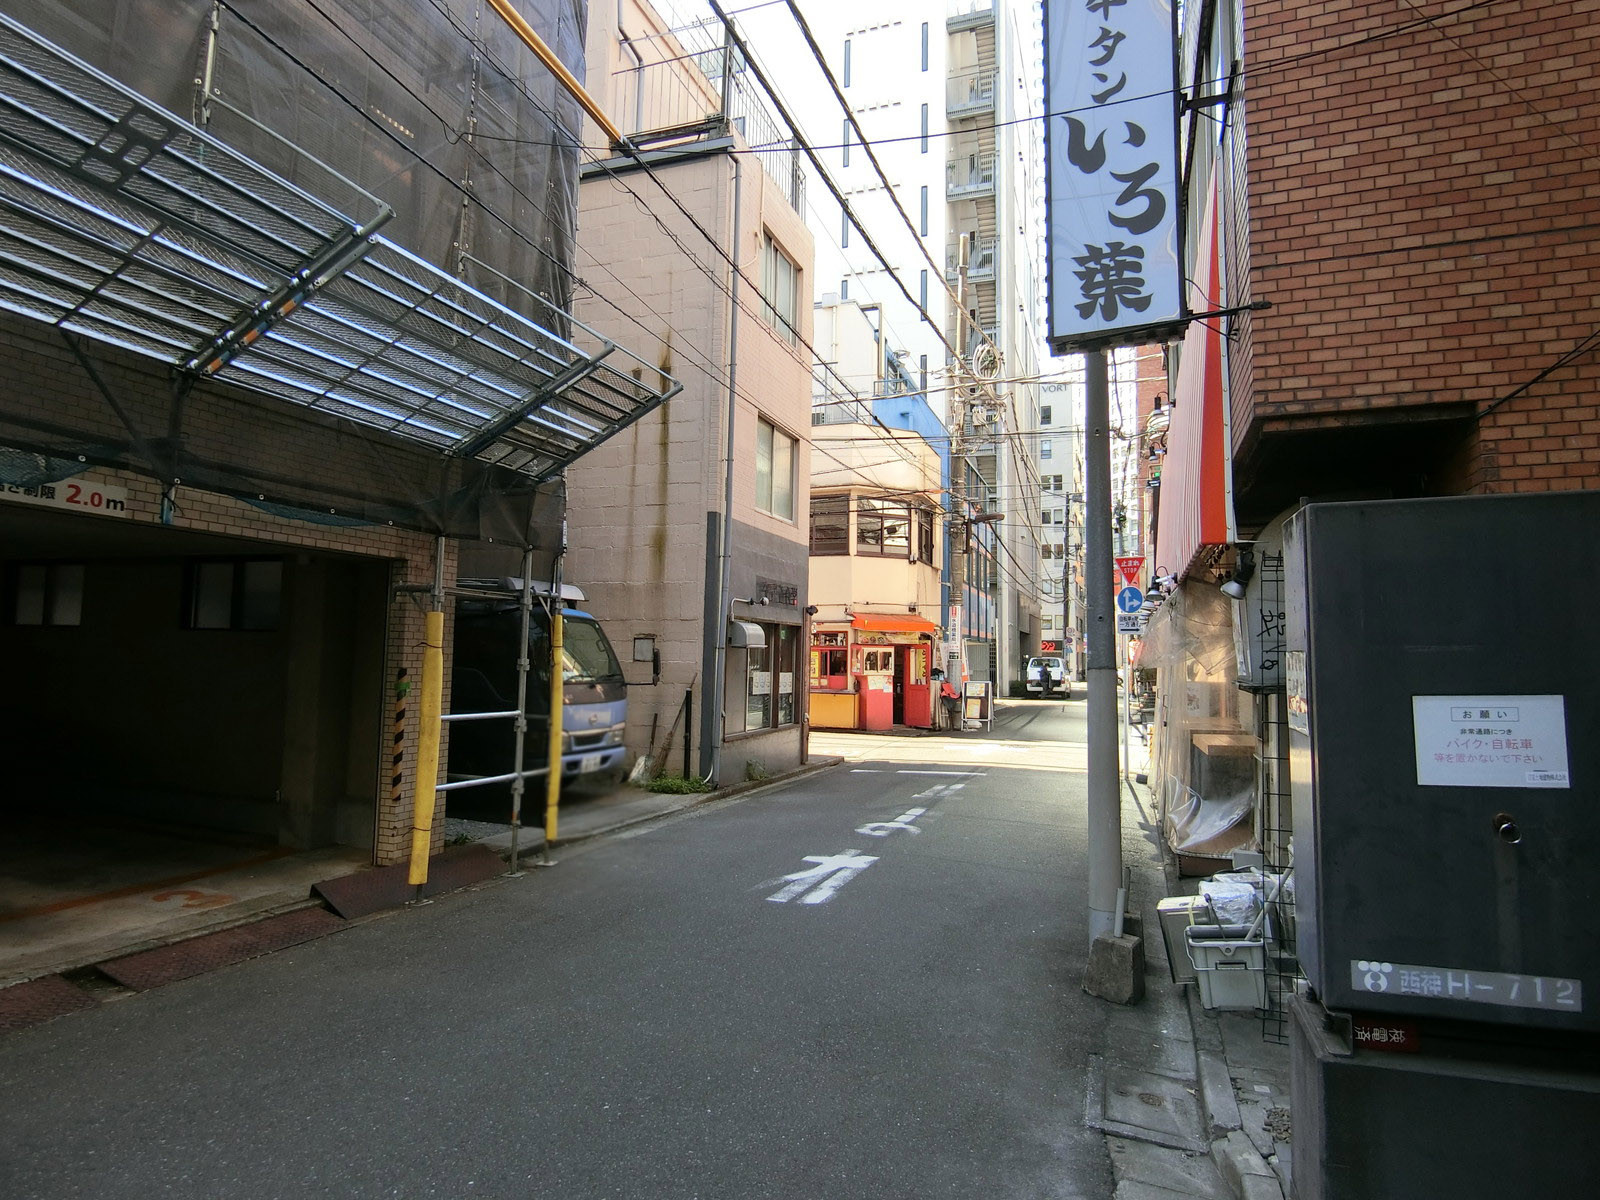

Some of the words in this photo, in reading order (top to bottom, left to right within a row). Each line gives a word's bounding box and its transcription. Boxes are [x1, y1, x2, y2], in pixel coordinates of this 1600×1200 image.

[1060, 114, 1167, 322] いろ葉
[1462, 709, 1508, 719] お願い
[1460, 728, 1513, 736] 非常通路につき
[1446, 738, 1534, 750] バイク・自転車
[1433, 753, 1543, 764] 等を置かないで下さい
[1353, 1025, 1407, 1045] 検電済
